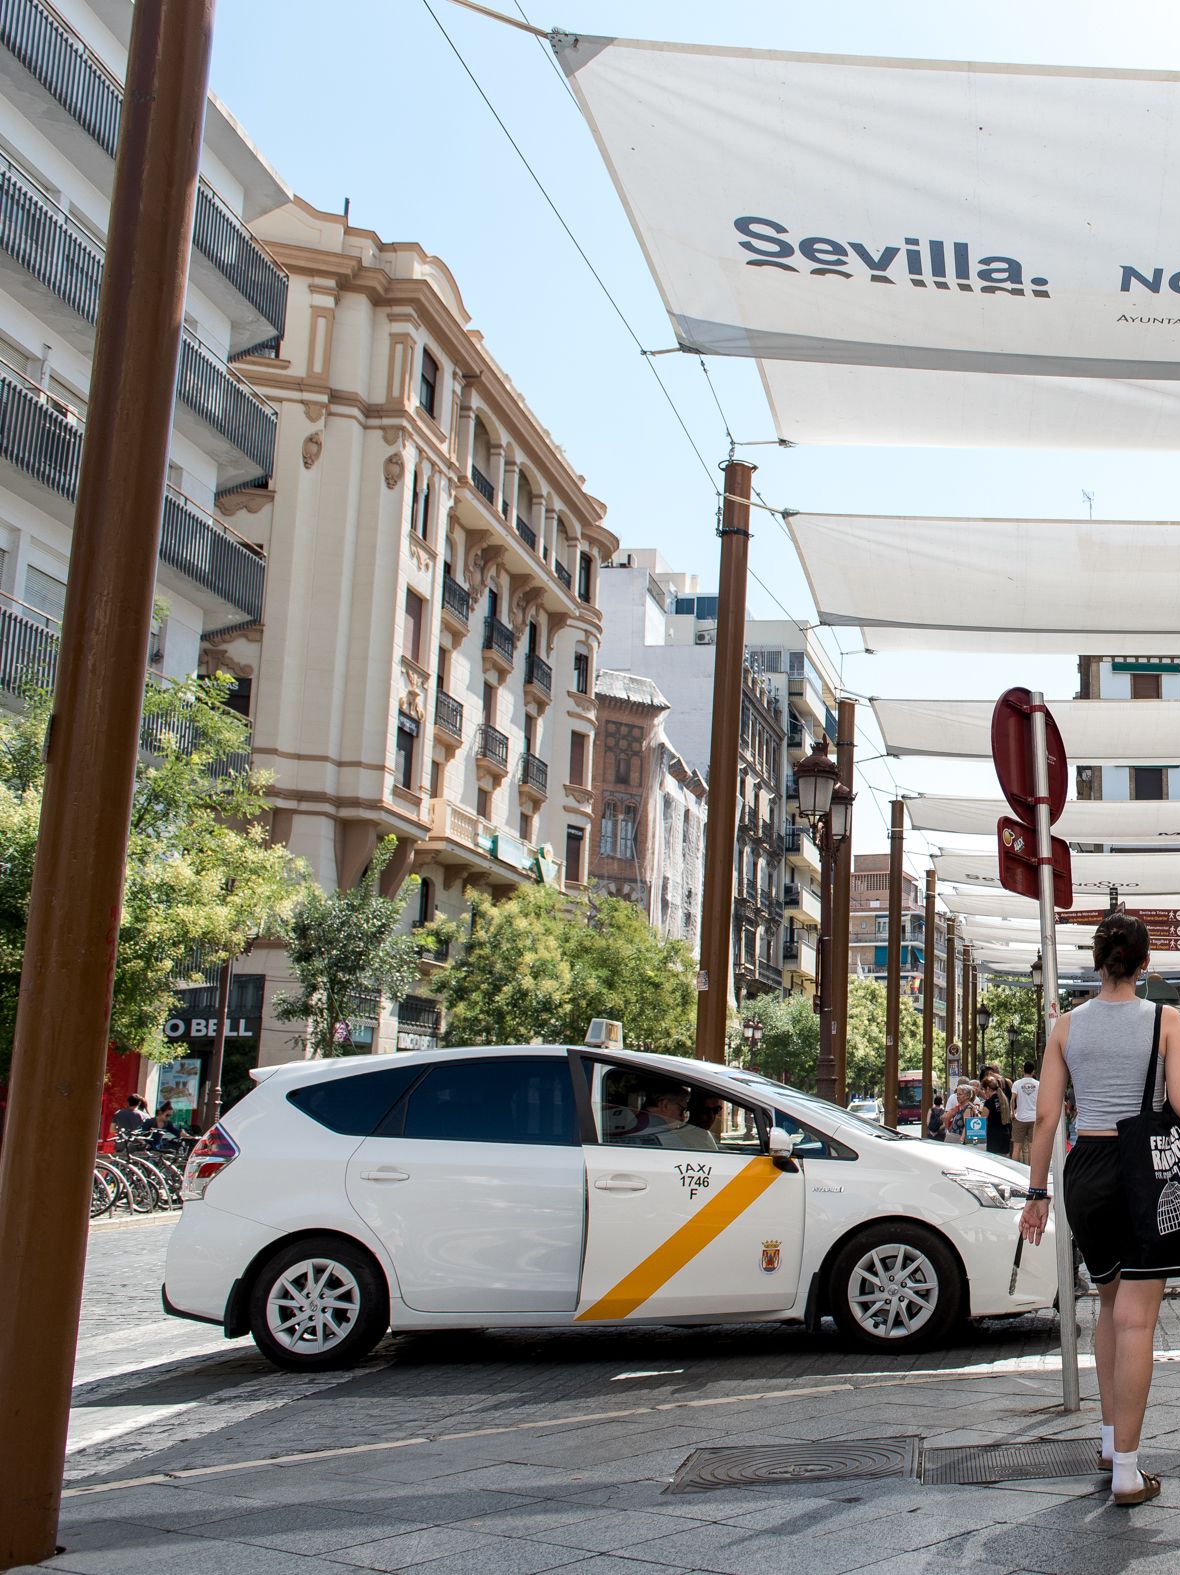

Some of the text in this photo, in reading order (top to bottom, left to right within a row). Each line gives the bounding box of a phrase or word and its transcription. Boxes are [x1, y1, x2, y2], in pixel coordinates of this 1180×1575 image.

[191, 1019, 253, 1037] BELL
[674, 1163, 712, 1176] TAXI
[680, 1176, 710, 1188] 1746
[690, 1188, 698, 1200] F
